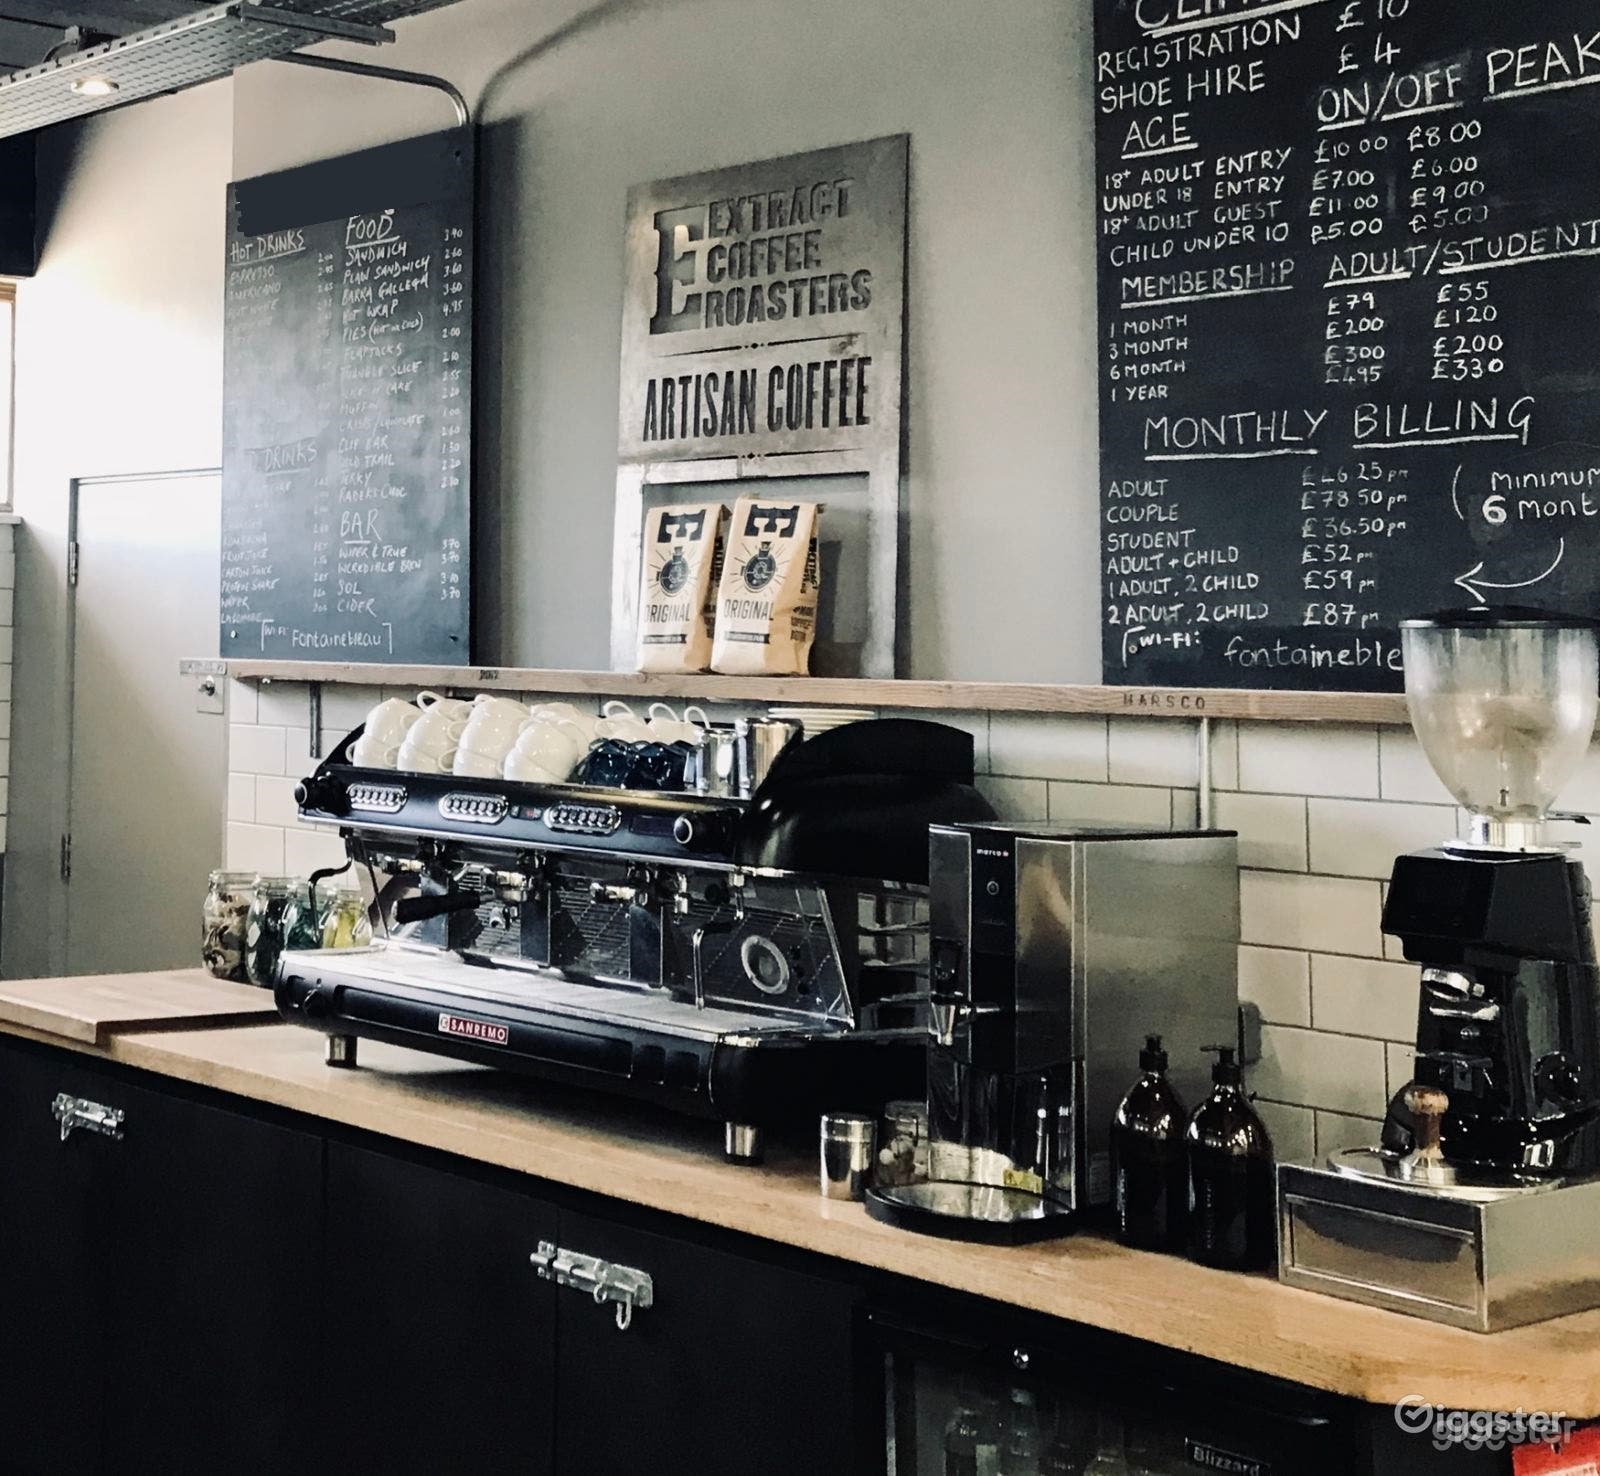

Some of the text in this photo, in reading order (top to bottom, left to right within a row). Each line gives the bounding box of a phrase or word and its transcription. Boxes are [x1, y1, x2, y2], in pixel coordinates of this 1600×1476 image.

[1098, 13, 1300, 82] REGISTRATION
[1101, 60, 1266, 113] SHOE HIRE
[1317, 31, 1600, 122] ON/OFF PEAK
[1123, 112, 1191, 151] AGE
[1141, 161, 1205, 186] ADULT
[1215, 147, 1292, 175] ENTRY
[1312, 170, 1375, 191] £7.00
[1103, 176, 1284, 212] UNDER 18 ENTRY
[708, 176, 855, 239] EXTRACT
[1136, 210, 1199, 231] ADULT
[1214, 200, 1281, 223] GUEST
[345, 214, 393, 245] FOOD
[256, 228, 305, 258] DRINKS
[345, 241, 407, 268] SANDWICH
[1110, 222, 1289, 267] CHILD UNDER 10
[374, 255, 430, 280] SANDWICH
[706, 229, 823, 284] COFFEE
[1121, 258, 1295, 300] MEMBERSHIP
[705, 269, 874, 329] ROASTERS
[1327, 292, 1375, 315] £79
[1436, 280, 1489, 304] £55
[367, 299, 399, 318] WRAP
[1433, 304, 1497, 329] £120
[1123, 314, 1188, 334] MONTH
[1325, 316, 1384, 340] £200
[1109, 337, 1188, 360] 3 MONTH
[1324, 345, 1385, 365] £300
[1433, 334, 1504, 358] £200
[1109, 359, 1186, 380] 6 MONTH
[1431, 358, 1504, 381] £330
[643, 356, 873, 442] ARTISAN COFFEE
[1125, 384, 1168, 401] YEAR
[1144, 395, 1535, 450] MONTHLY BILLING
[364, 453, 395, 468] TRAIL
[1108, 478, 1169, 498] ADULT
[1106, 504, 1179, 524] COUPLE
[1482, 495, 1508, 523] 6
[340, 508, 382, 541] BAR
[381, 545, 408, 559] TRUE
[1107, 529, 1196, 552] STUDENT
[1301, 543, 1352, 564] £52
[337, 579, 362, 596] SOL
[1185, 575, 1198, 593] 2
[1202, 573, 1259, 592] CHILD
[1302, 569, 1353, 590] £59
[337, 598, 377, 618] CIDER
[644, 602, 691, 623] ORIGINAL
[723, 599, 774, 622] ORIGINAL
[1108, 605, 1120, 625] 2
[1196, 603, 1210, 623] 2
[1213, 603, 1269, 622] CHILD
[1303, 602, 1357, 626] £87
[451, 1018, 506, 1041] SANREMO
